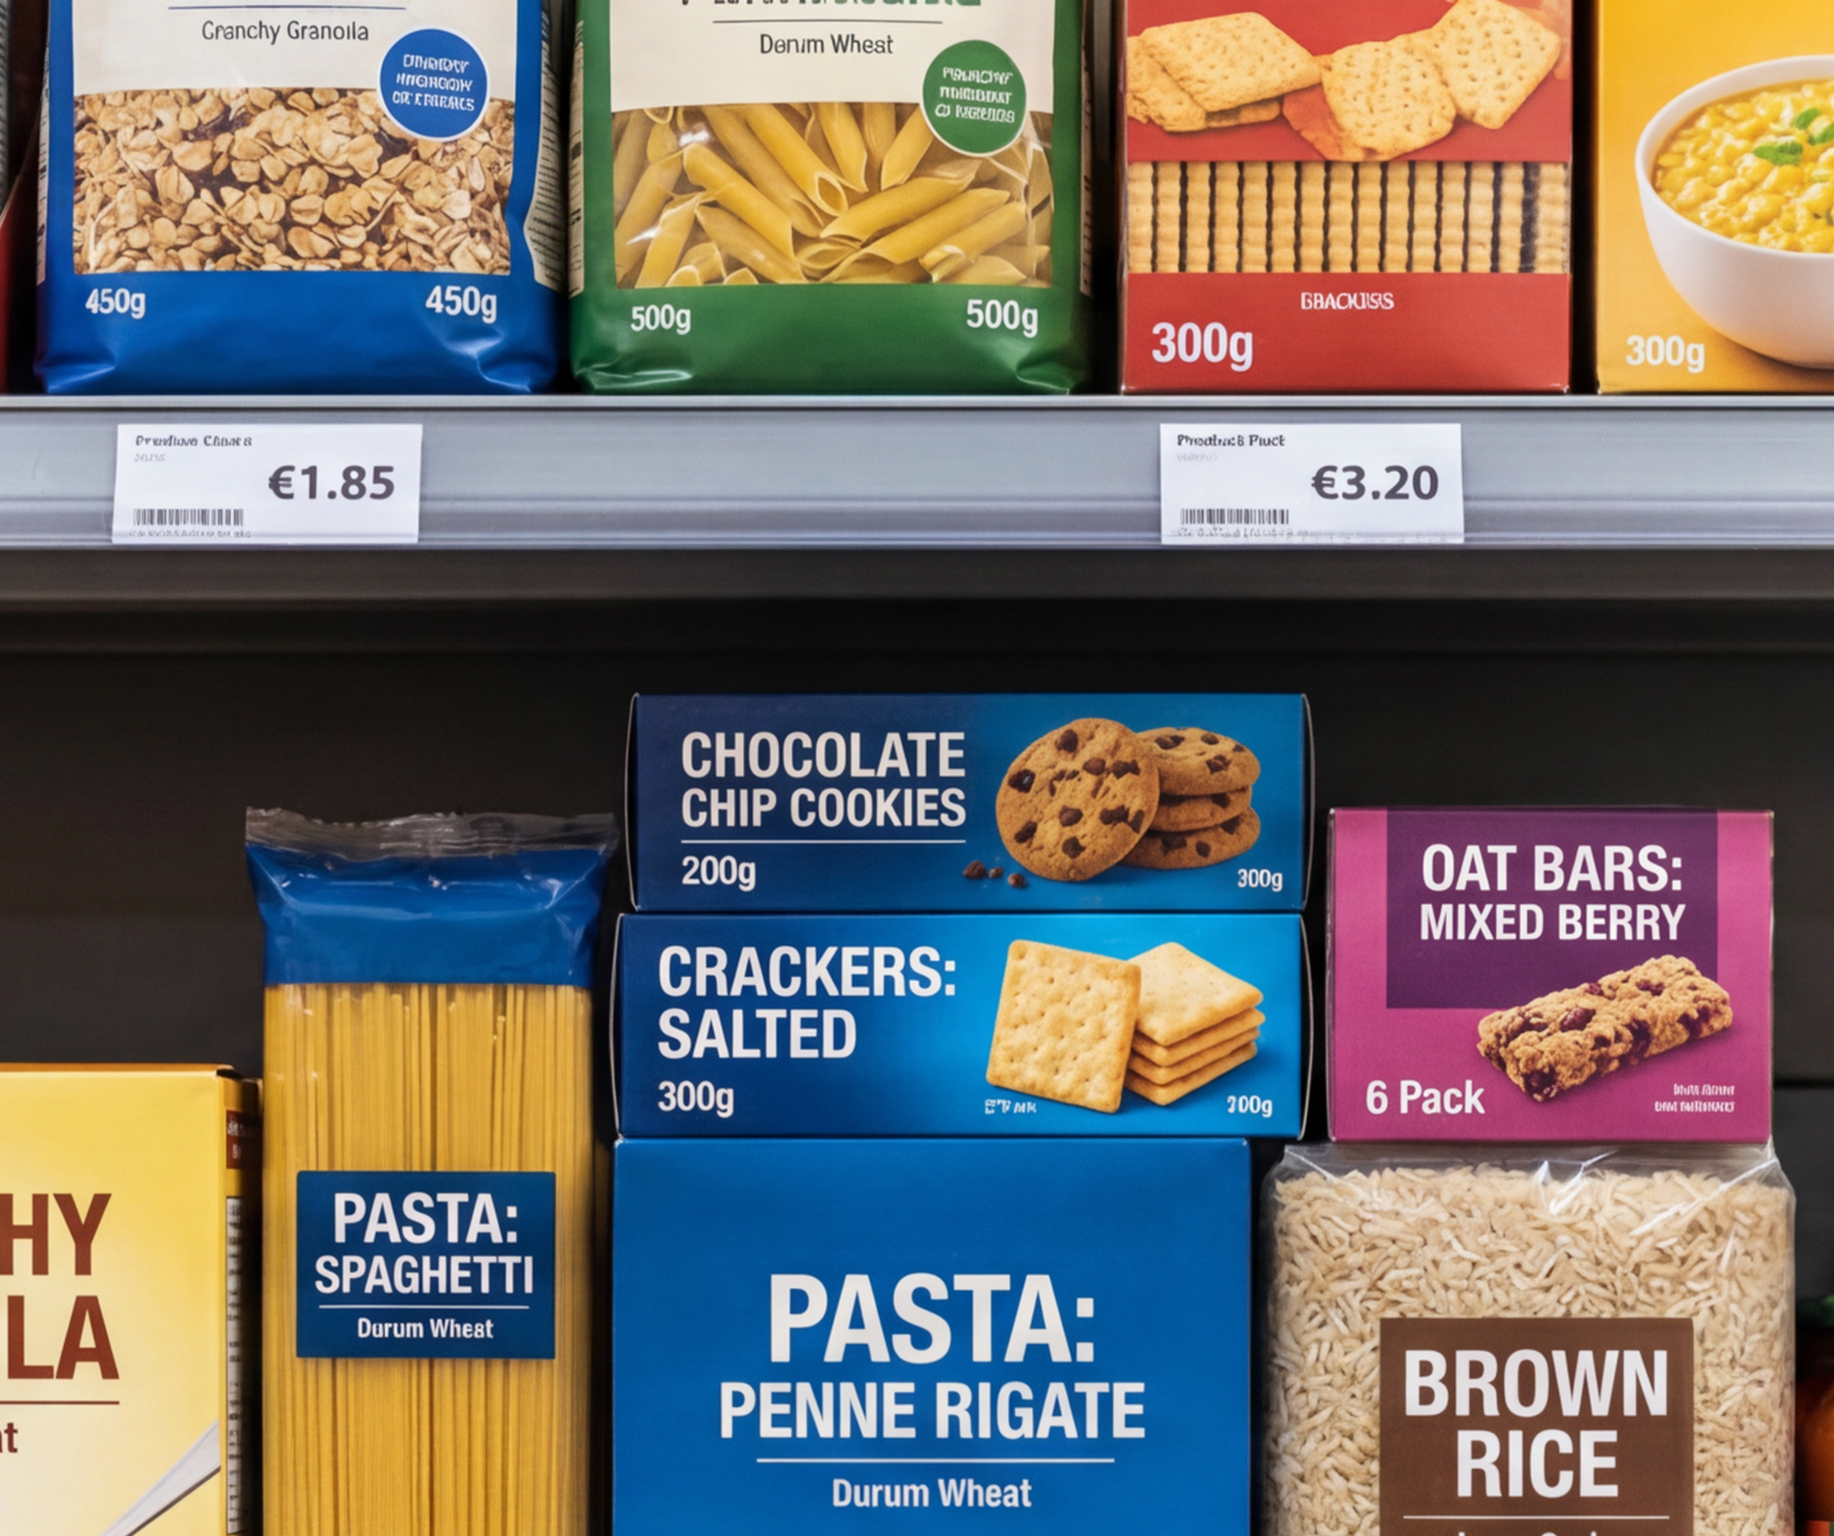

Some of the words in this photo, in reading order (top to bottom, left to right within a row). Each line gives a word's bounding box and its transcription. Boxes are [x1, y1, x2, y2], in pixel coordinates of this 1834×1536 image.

[85, 288, 146, 318] 450g
[425, 285, 498, 324] 450g
[630, 304, 692, 335] 500g
[966, 299, 1039, 337] 500g
[1151, 322, 1254, 371] 300g
[1625, 334, 1705, 373] 300g
[268, 465, 395, 500] €1.85
[1311, 465, 1439, 500] €3.20
[681, 731, 965, 778] CHOCOLATE
[681, 788, 777, 828] CHIP
[790, 787, 966, 828] COOKIES
[681, 855, 756, 891] 200g
[1237, 868, 1283, 893] 300g
[1422, 843, 1518, 892] OAT
[1534, 844, 1683, 893] BARS:
[1420, 903, 1544, 941] MIXED
[1558, 903, 1686, 941] BERRY
[658, 945, 956, 998] CRACKERS:
[658, 1008, 857, 1060] SALTED
[658, 1080, 734, 1118] 300g
[1366, 1080, 1388, 1115] 6
[1400, 1079, 1485, 1115] Pack
[334, 1192, 518, 1244] PASTA:
[315, 1255, 533, 1294] SPAGHETTI
[770, 1272, 1094, 1364] PASTA:
[1405, 1349, 1667, 1418] BROWN
[720, 1382, 916, 1439] PENNE
[935, 1381, 1146, 1440] RIGATE
[1457, 1429, 1619, 1498] RICE
[833, 1478, 929, 1508] Durum
[938, 1478, 1032, 1508] Wheat
